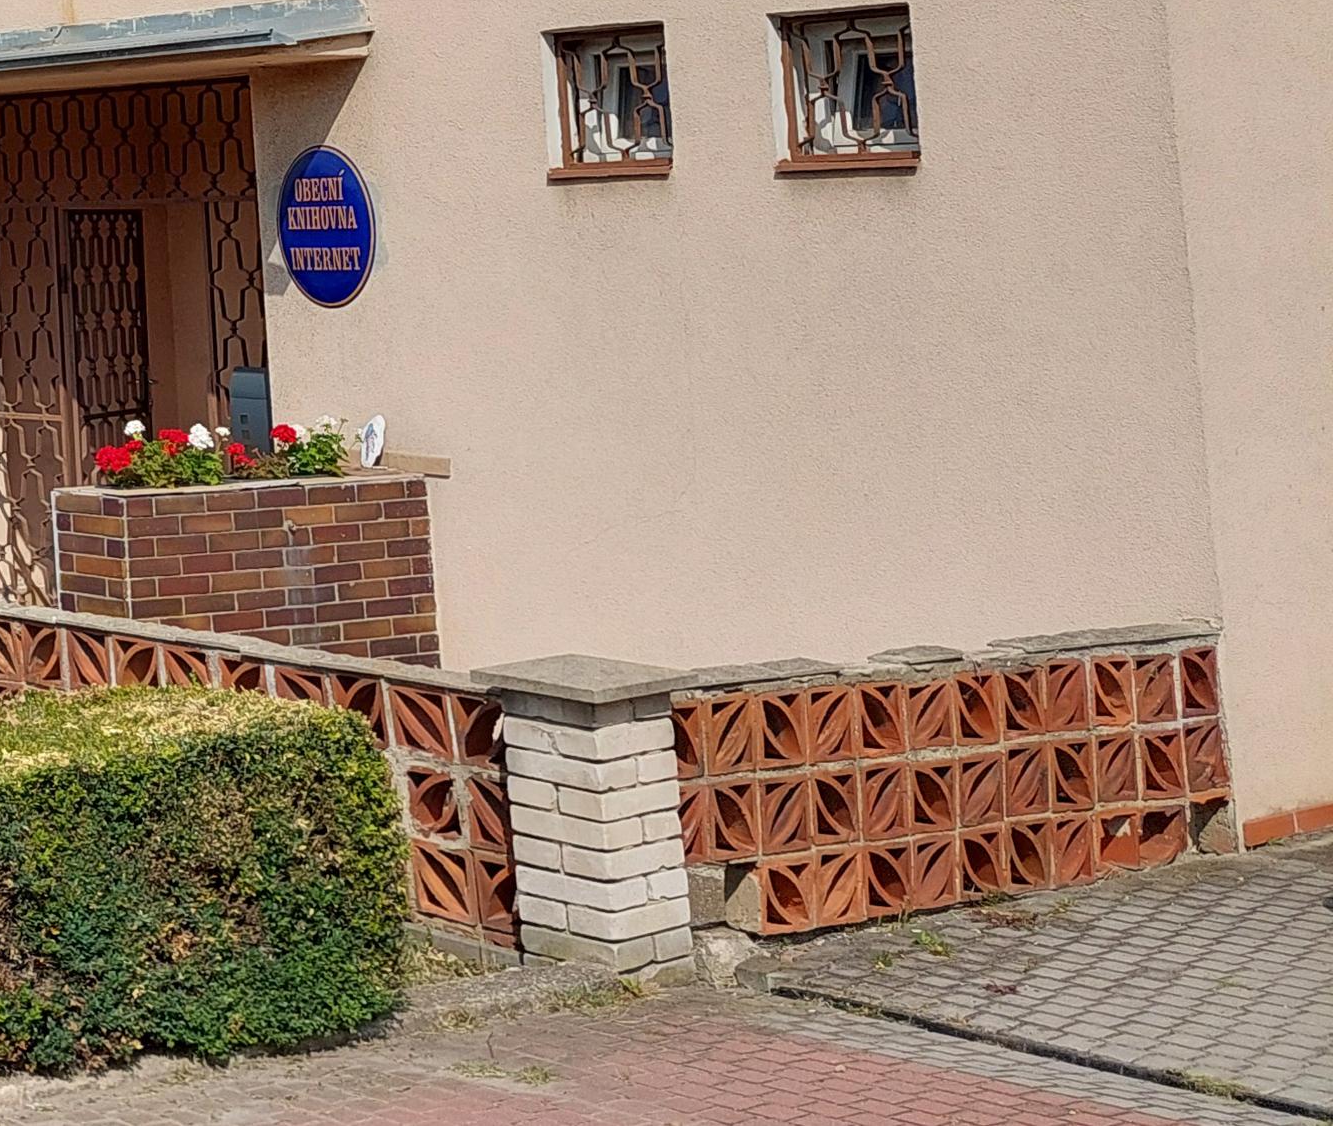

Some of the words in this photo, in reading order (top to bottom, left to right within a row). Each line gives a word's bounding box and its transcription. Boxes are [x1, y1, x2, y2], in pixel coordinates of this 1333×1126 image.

[294, 169, 344, 202] OBECNÍ
[287, 205, 358, 230] KNIHOVNA
[290, 247, 361, 272] INTERNET
